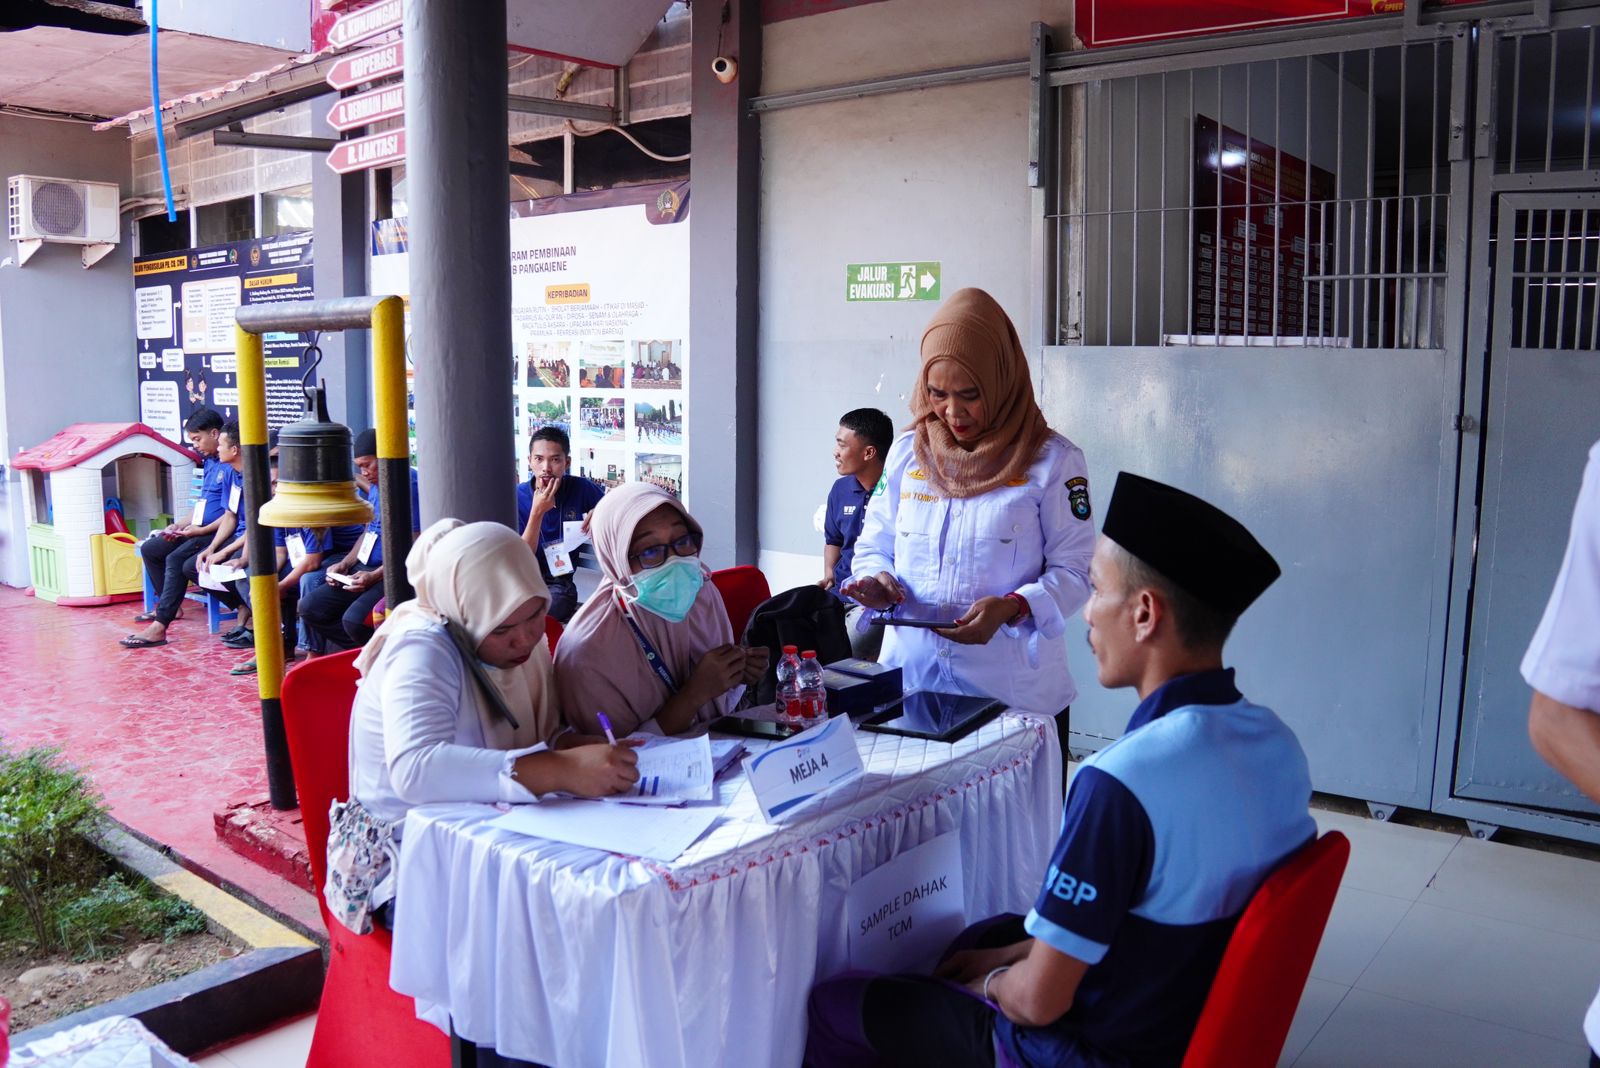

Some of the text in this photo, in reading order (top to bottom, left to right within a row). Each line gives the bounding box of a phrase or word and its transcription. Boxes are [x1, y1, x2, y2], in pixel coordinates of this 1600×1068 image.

[351, 47, 397, 79] KOPERASI
[358, 135, 398, 162] LAKTASI
[529, 246, 577, 260] PEMBINAAN
[519, 261, 568, 274] PANGKAJENE
[857, 266, 888, 282] JALUR
[547, 289, 588, 299] KEPRIBADIAN
[849, 283, 895, 299] EVAKUASI
[913, 492, 939, 503] TOMPO
[789, 757, 821, 784] MEJA
[821, 752, 829, 768] 4
[860, 874, 947, 936] SAMPLE DAHAK
[887, 917, 913, 941] TCM
